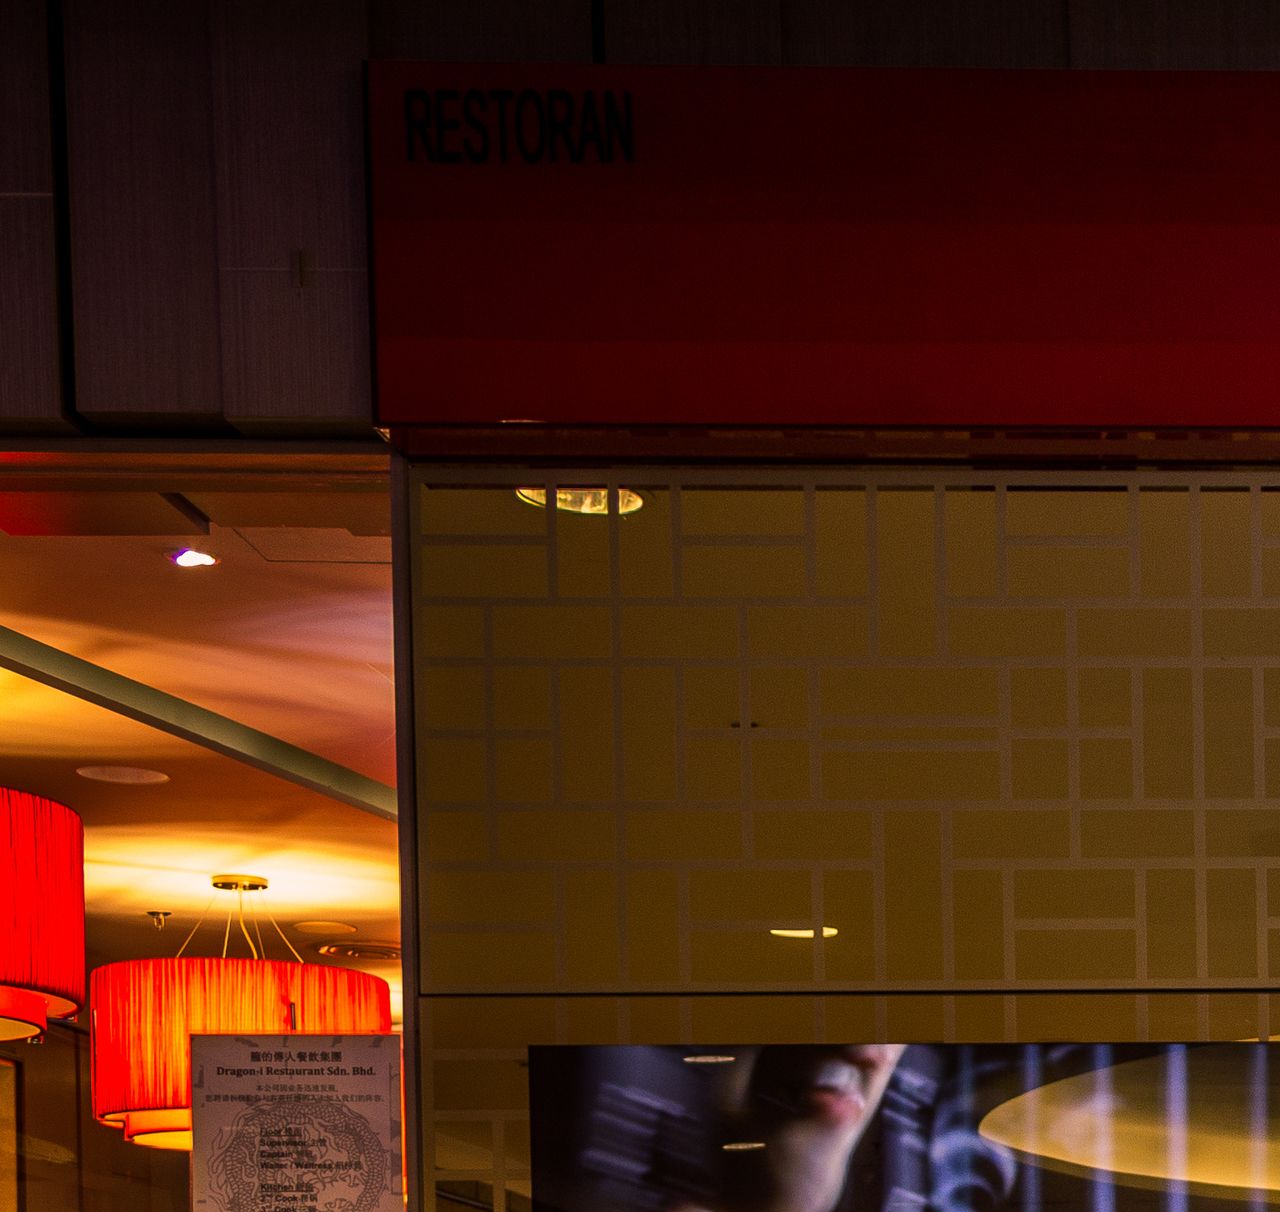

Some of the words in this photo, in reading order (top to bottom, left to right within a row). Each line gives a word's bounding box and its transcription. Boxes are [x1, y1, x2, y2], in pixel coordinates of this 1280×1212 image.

[404, 88, 634, 163] RESTORAN
[266, 1066, 326, 1076] Restaurant
[326, 1066, 350, 1076] Sdn.
[352, 1066, 376, 1076] Bhd.
[260, 1138, 306, 1148] Supervisor
[260, 1150, 293, 1160] Captain
[260, 1160, 287, 1169] Waiter
[295, 1160, 333, 1169] Waitress
[260, 1182, 294, 1192] Kitchen
[275, 1194, 298, 1202] Cook
